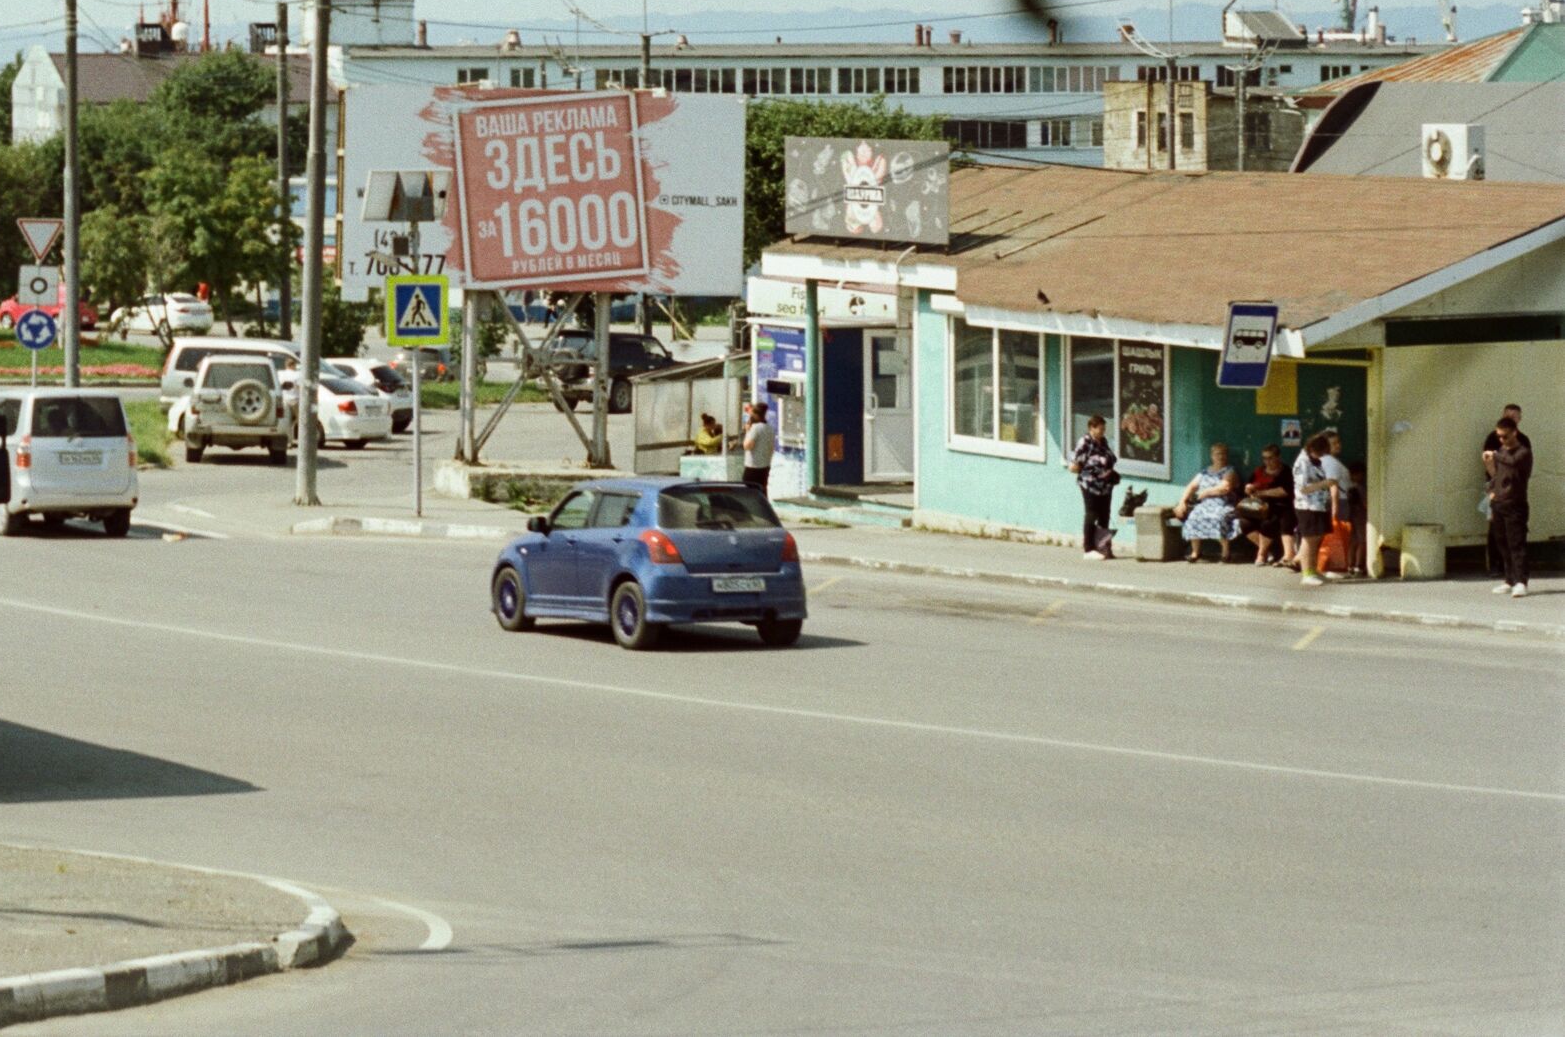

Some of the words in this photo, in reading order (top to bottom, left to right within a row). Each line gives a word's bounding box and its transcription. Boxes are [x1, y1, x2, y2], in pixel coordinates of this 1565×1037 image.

[475, 113, 529, 138] ВАША
[533, 105, 619, 134] РЕКЛАМА
[485, 131, 622, 194] ЗДЕСЬ
[478, 220, 497, 239] ЗА
[494, 190, 638, 258] 16000
[512, 255, 564, 274] РУБЛЕЙ
[566, 254, 575, 271] В
[578, 250, 623, 269] МЕСЯЦ
[777, 303, 796, 314] sea
